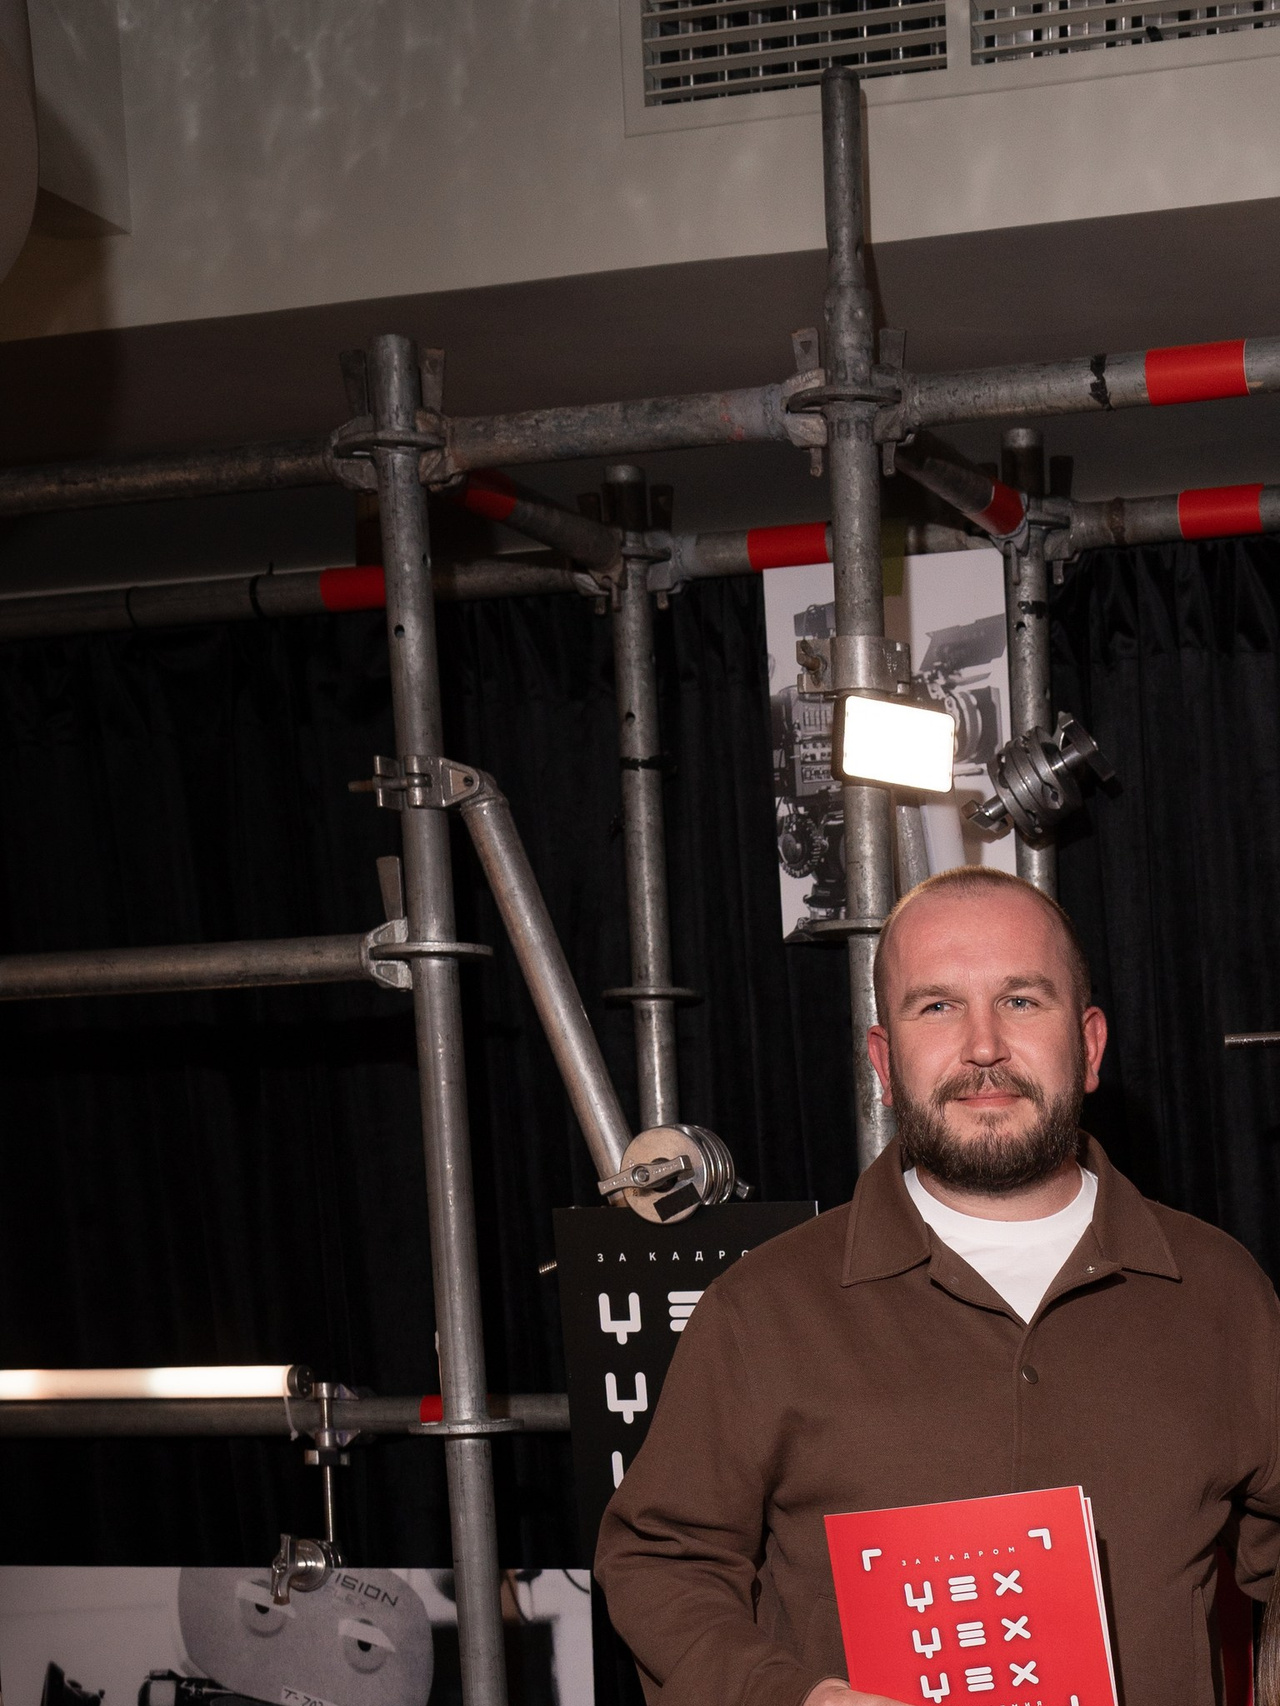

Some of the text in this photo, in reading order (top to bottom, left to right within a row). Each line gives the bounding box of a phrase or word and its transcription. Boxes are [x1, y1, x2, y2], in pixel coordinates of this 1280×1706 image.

[597, 1252, 627, 1263] ЗА
[598, 1290, 705, 1345] ЦЕ
[901, 1545, 1016, 1567] ЗА КАДРОМ
[333, 1571, 399, 1608] ISION
